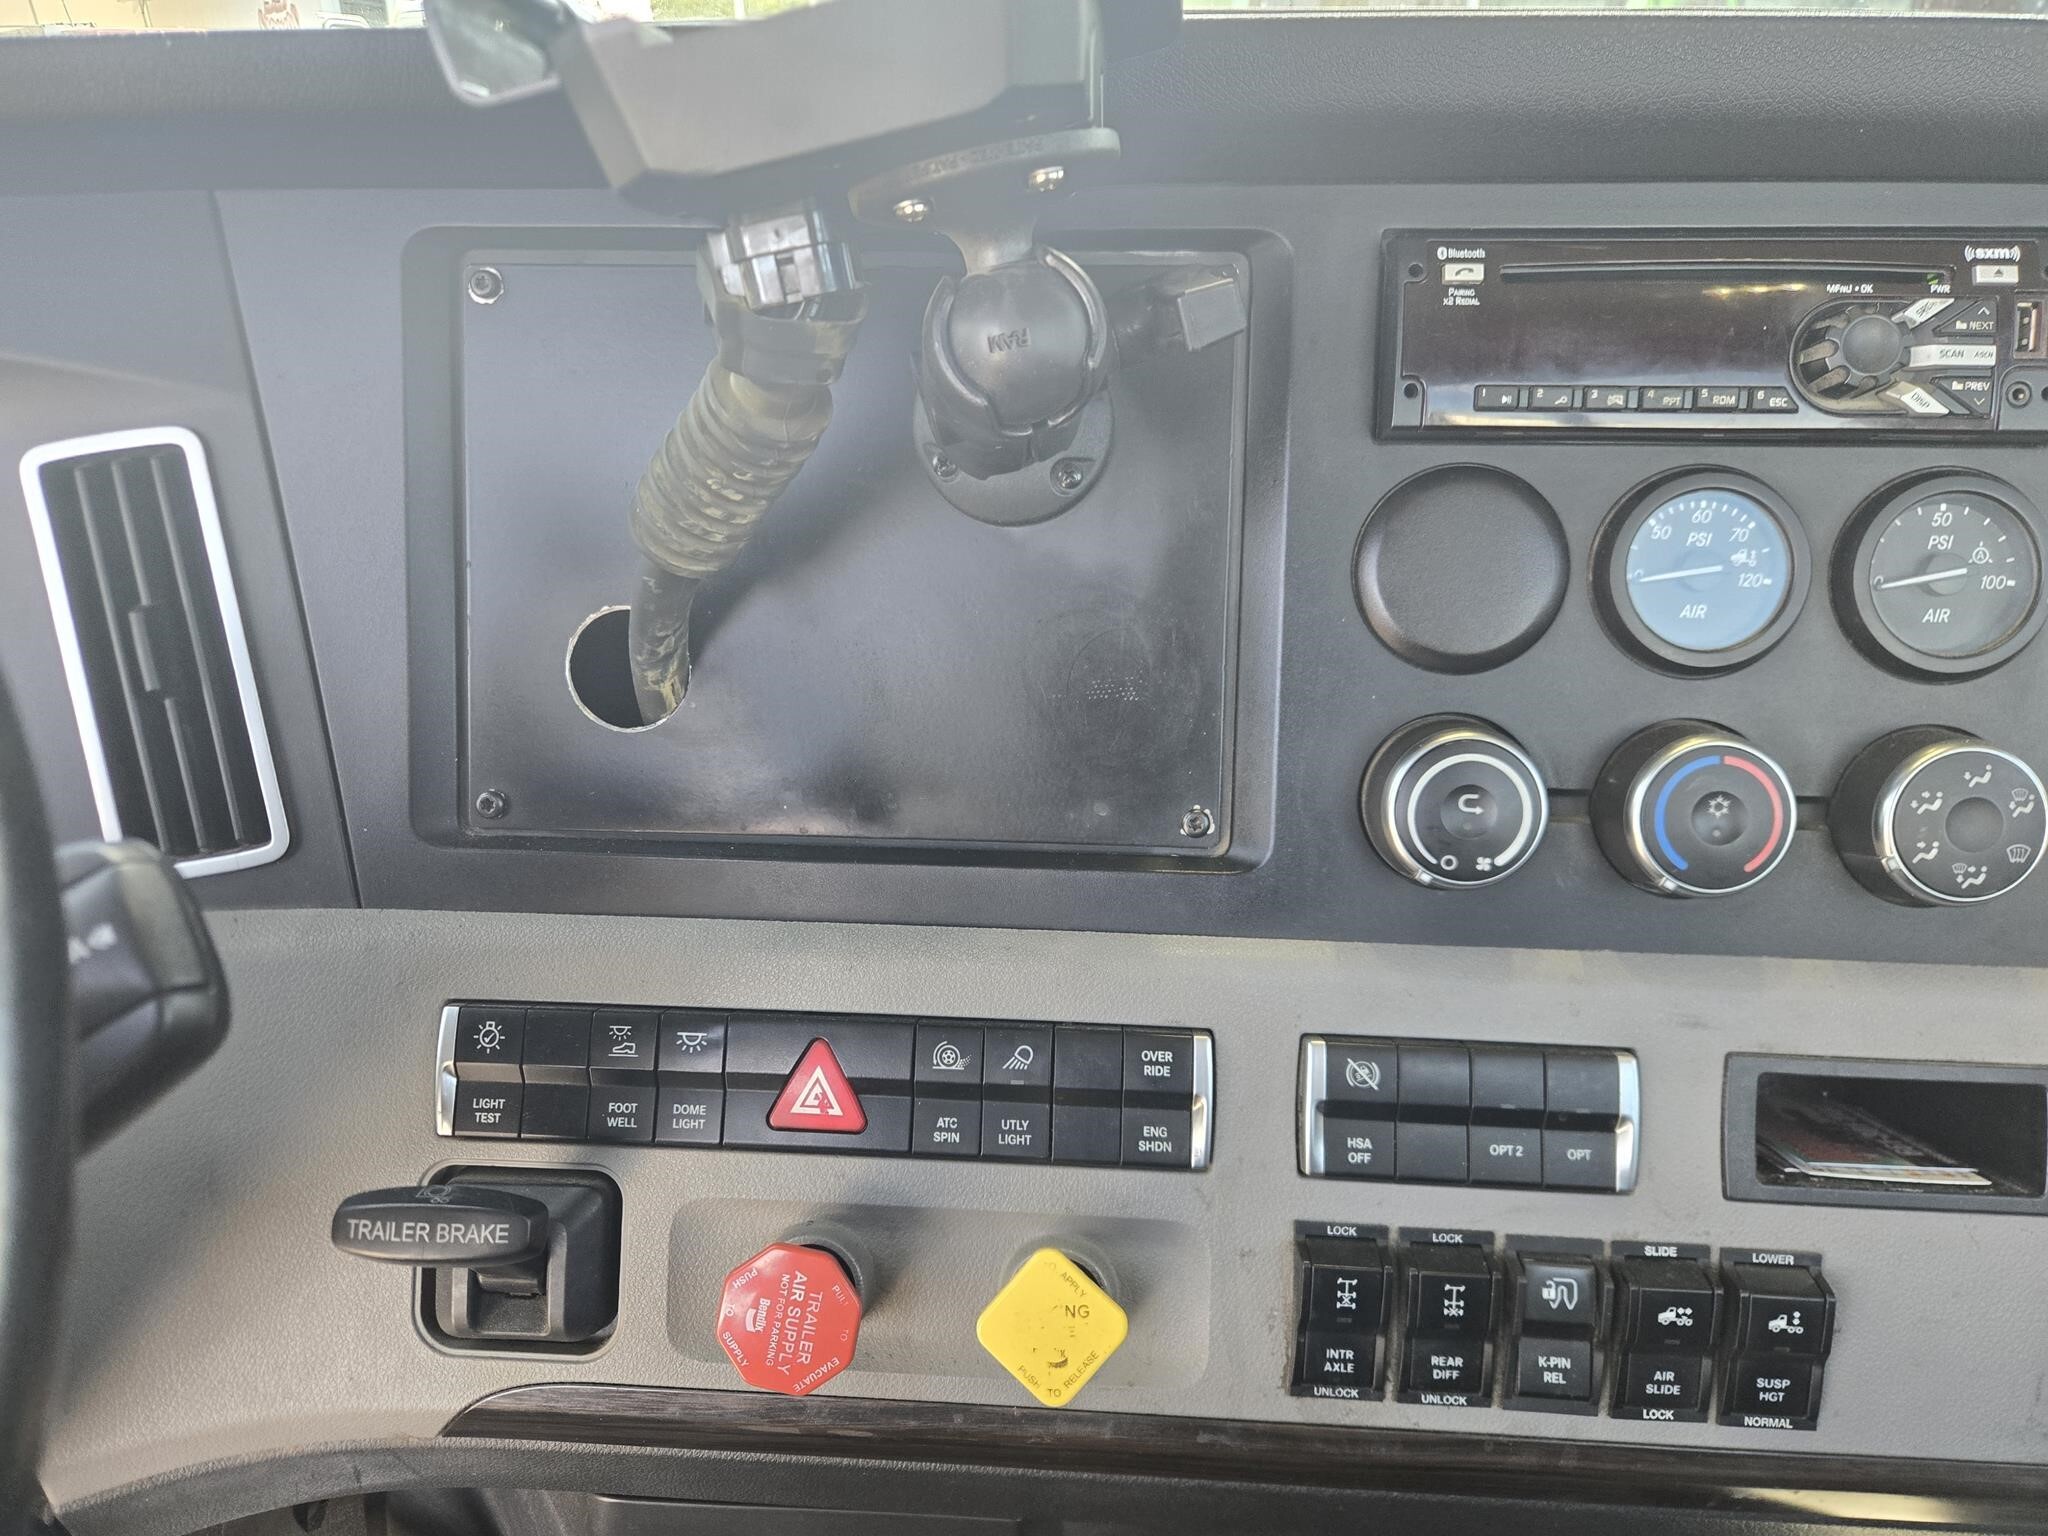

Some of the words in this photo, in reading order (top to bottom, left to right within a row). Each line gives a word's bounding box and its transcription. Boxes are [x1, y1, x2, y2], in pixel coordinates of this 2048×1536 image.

[1448, 247, 1486, 259] Bluetooth
[1975, 248, 2011, 261] sxm
[1860, 283, 1874, 294] OK
[1930, 284, 1951, 294] PWR
[1969, 321, 1994, 331] NEXT
[987, 327, 1031, 353] RAM
[1940, 349, 1965, 359] SCAN
[1536, 388, 1544, 398] 2
[1701, 388, 1709, 398] 5
[1964, 381, 1990, 392] PREV
[1591, 389, 1599, 399] 3
[1757, 390, 1765, 400] 6
[1662, 396, 1682, 406] RPT
[1769, 397, 1788, 407] ESC
[1691, 509, 1712, 524] 60
[1931, 512, 1953, 527] 50
[1650, 525, 1672, 540] 50
[1728, 527, 1750, 543] 70
[1686, 532, 1713, 547] PSI
[1927, 535, 1954, 550] PSI
[1737, 572, 1763, 588] 120
[1980, 575, 2007, 590] 100
[1679, 604, 1708, 619] AIR
[1922, 608, 1951, 623] AIR
[1141, 1050, 1173, 1063] OVER
[1143, 1065, 1171, 1077] RIDE
[472, 1098, 506, 1110] LIGHT
[608, 1102, 638, 1114] FOOT
[672, 1103, 707, 1116] DOME
[474, 1112, 502, 1124] TEST
[607, 1117, 638, 1128] WELL
[672, 1118, 706, 1129] LIGHT
[936, 1117, 958, 1129] ATC
[1001, 1119, 1030, 1132] UTLY
[1143, 1126, 1168, 1138] ENG
[933, 1131, 960, 1144] SPIN
[998, 1134, 1032, 1146] LIGHT
[1347, 1137, 1372, 1150] HSA
[1138, 1140, 1172, 1153] SHDN
[1489, 1144, 1514, 1157] OPT
[1515, 1145, 1523, 1157] 2
[1347, 1152, 1371, 1164] OFF
[1567, 1149, 1592, 1161] OPT
[347, 1219, 430, 1243] TRAILER
[436, 1222, 510, 1244] BRAKE
[1327, 1225, 1357, 1237] LOCK
[1432, 1232, 1463, 1244] LOCK
[1644, 1245, 1678, 1258] SLIDE
[1752, 1252, 1794, 1266] LOWER
[732, 1267, 758, 1290] PUSH
[779, 1273, 790, 1296] NOT
[1061, 1271, 1087, 1298] APPLY
[790, 1270, 808, 1301] AIR
[725, 1303, 735, 1317] TO
[775, 1297, 787, 1319] FOR
[754, 1297, 771, 1334] Bendix
[796, 1291, 823, 1365] TRAILER
[765, 1320, 782, 1367] PARKING
[777, 1306, 801, 1376] SUPPLY
[722, 1331, 750, 1367] SUPPLY
[1326, 1348, 1354, 1360] INTR
[1323, 1362, 1355, 1374] AXLE
[1431, 1355, 1463, 1368] REAR
[1538, 1356, 1571, 1369] K-PIN
[793, 1357, 840, 1393] EVACUATE
[1017, 1364, 1041, 1388] PUSH
[1048, 1388, 1062, 1398] TO
[1063, 1350, 1099, 1388] RELEASE
[1433, 1369, 1460, 1381] DIFF
[1543, 1371, 1566, 1384] REL
[1653, 1371, 1675, 1383] AIR
[1645, 1383, 1681, 1396] SLIDE
[1756, 1377, 1791, 1390] SUSP
[1313, 1386, 1359, 1399] UNLOCK
[1759, 1391, 1785, 1403] HGT
[1421, 1393, 1468, 1406] UNLOCK
[1643, 1408, 1674, 1421] LOCK
[1744, 1415, 1793, 1429] NORMAL
